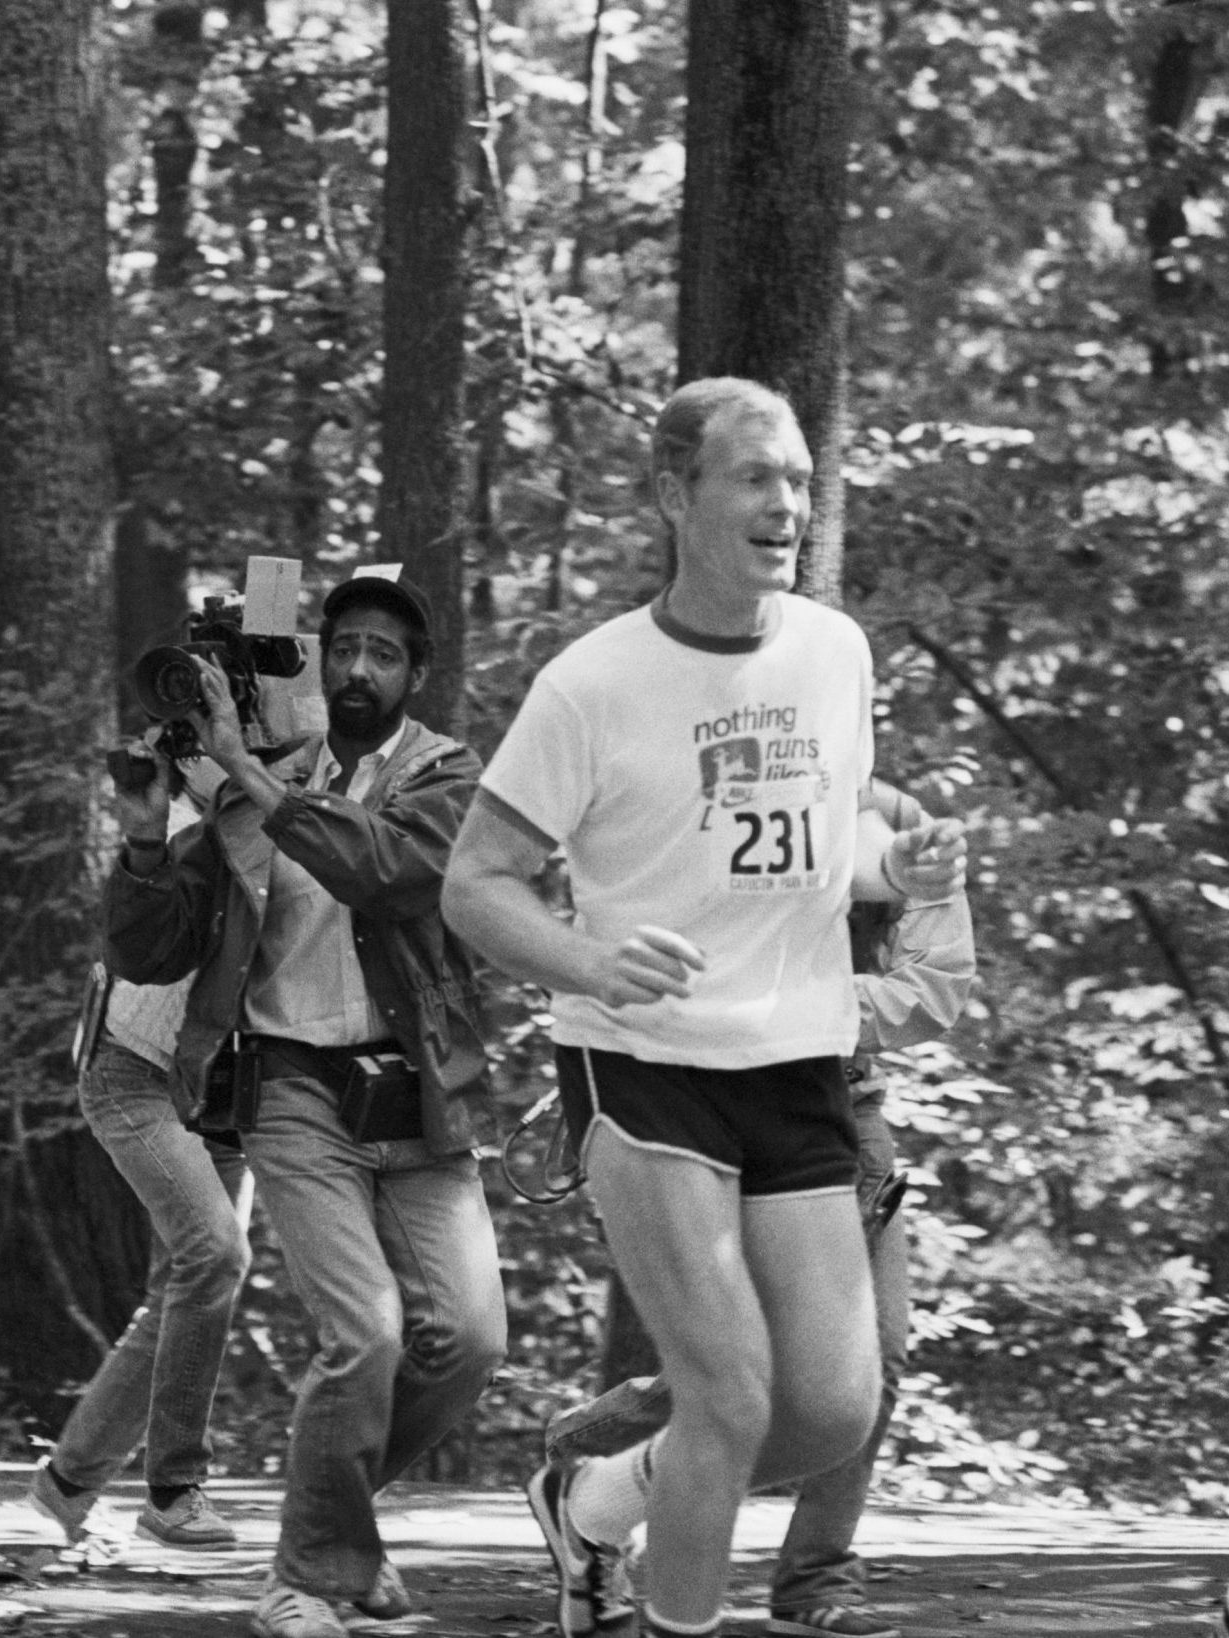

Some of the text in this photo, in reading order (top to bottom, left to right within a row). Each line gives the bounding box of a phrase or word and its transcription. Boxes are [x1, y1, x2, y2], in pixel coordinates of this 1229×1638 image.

[694, 703, 796, 742] nothing
[766, 738, 819, 760] runs
[730, 807, 815, 874] 231
